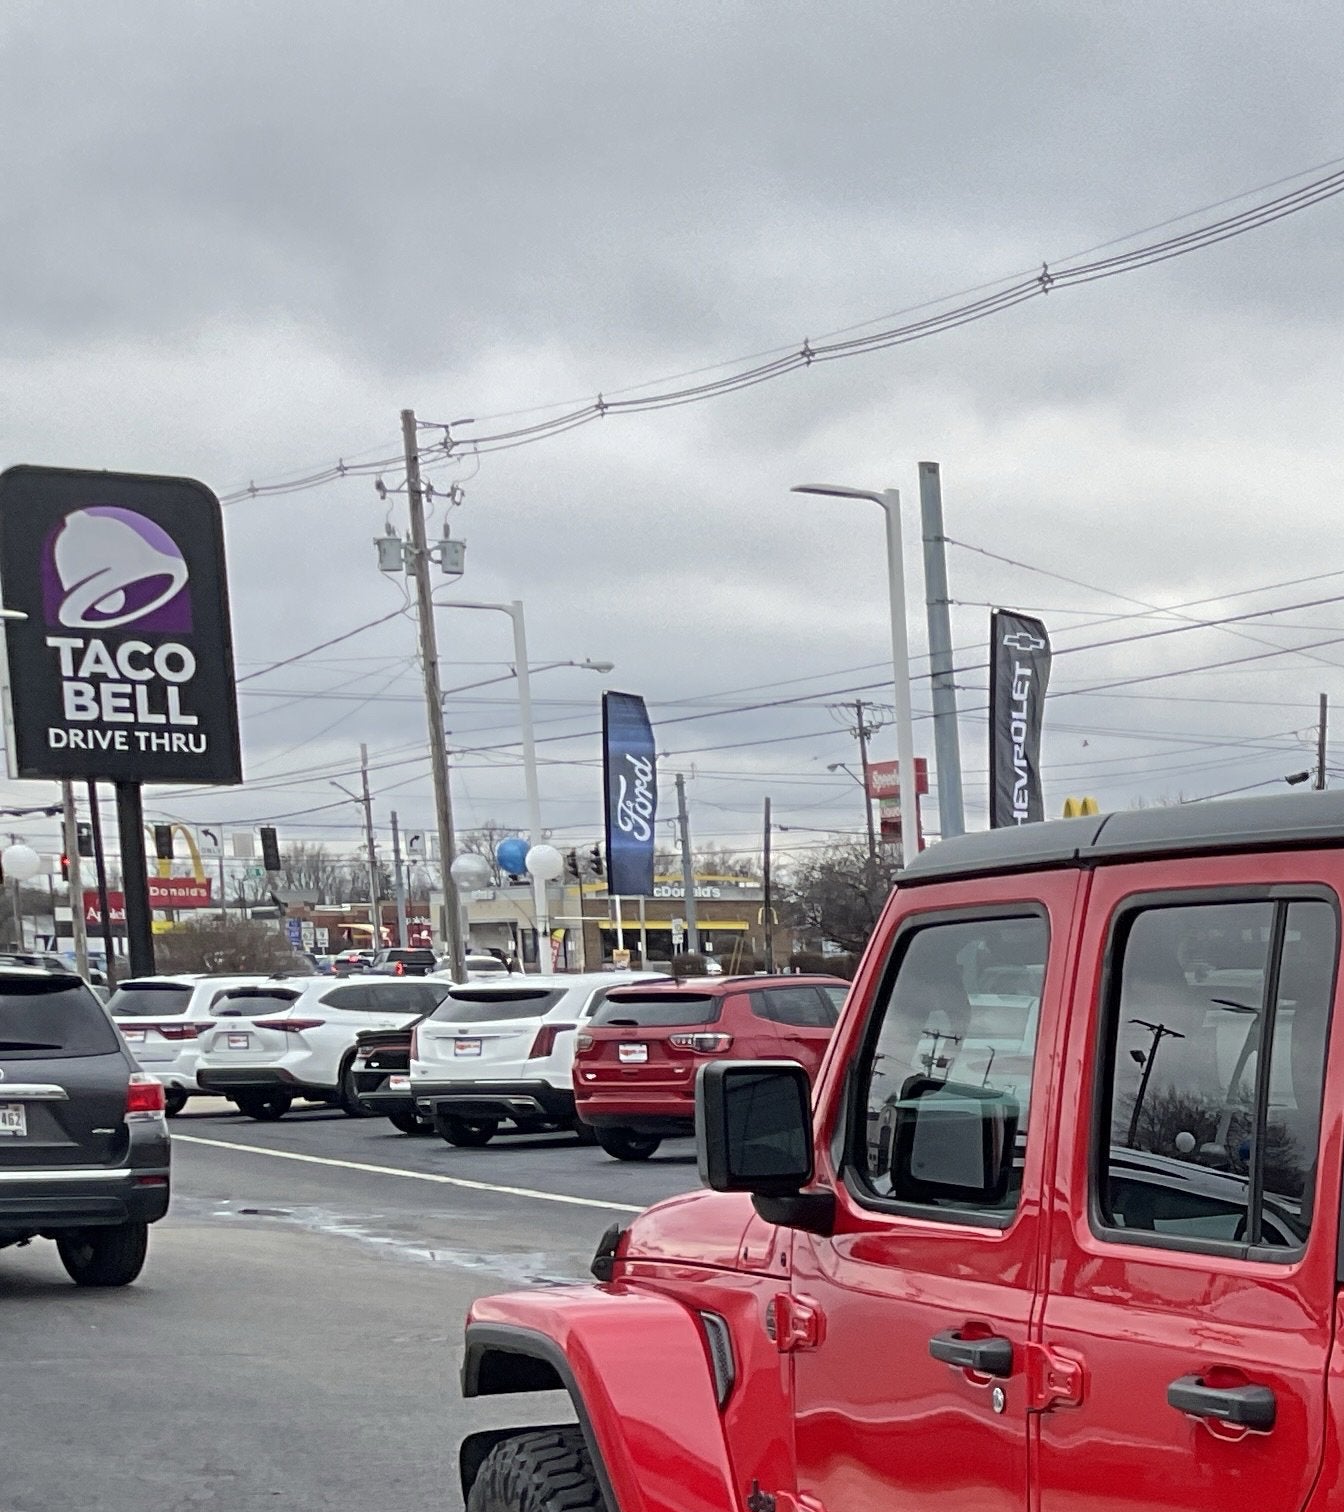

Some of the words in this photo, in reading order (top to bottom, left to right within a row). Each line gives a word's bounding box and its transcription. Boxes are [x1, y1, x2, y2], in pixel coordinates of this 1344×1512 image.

[46, 636, 196, 683] TACO
[62, 681, 198, 725] BELL
[48, 728, 129, 750] DRIVE
[134, 731, 207, 753] THRU
[1010, 661, 1032, 827] HEVROLET
[617, 753, 652, 842] Ford
[149, 886, 207, 897] Donald's
